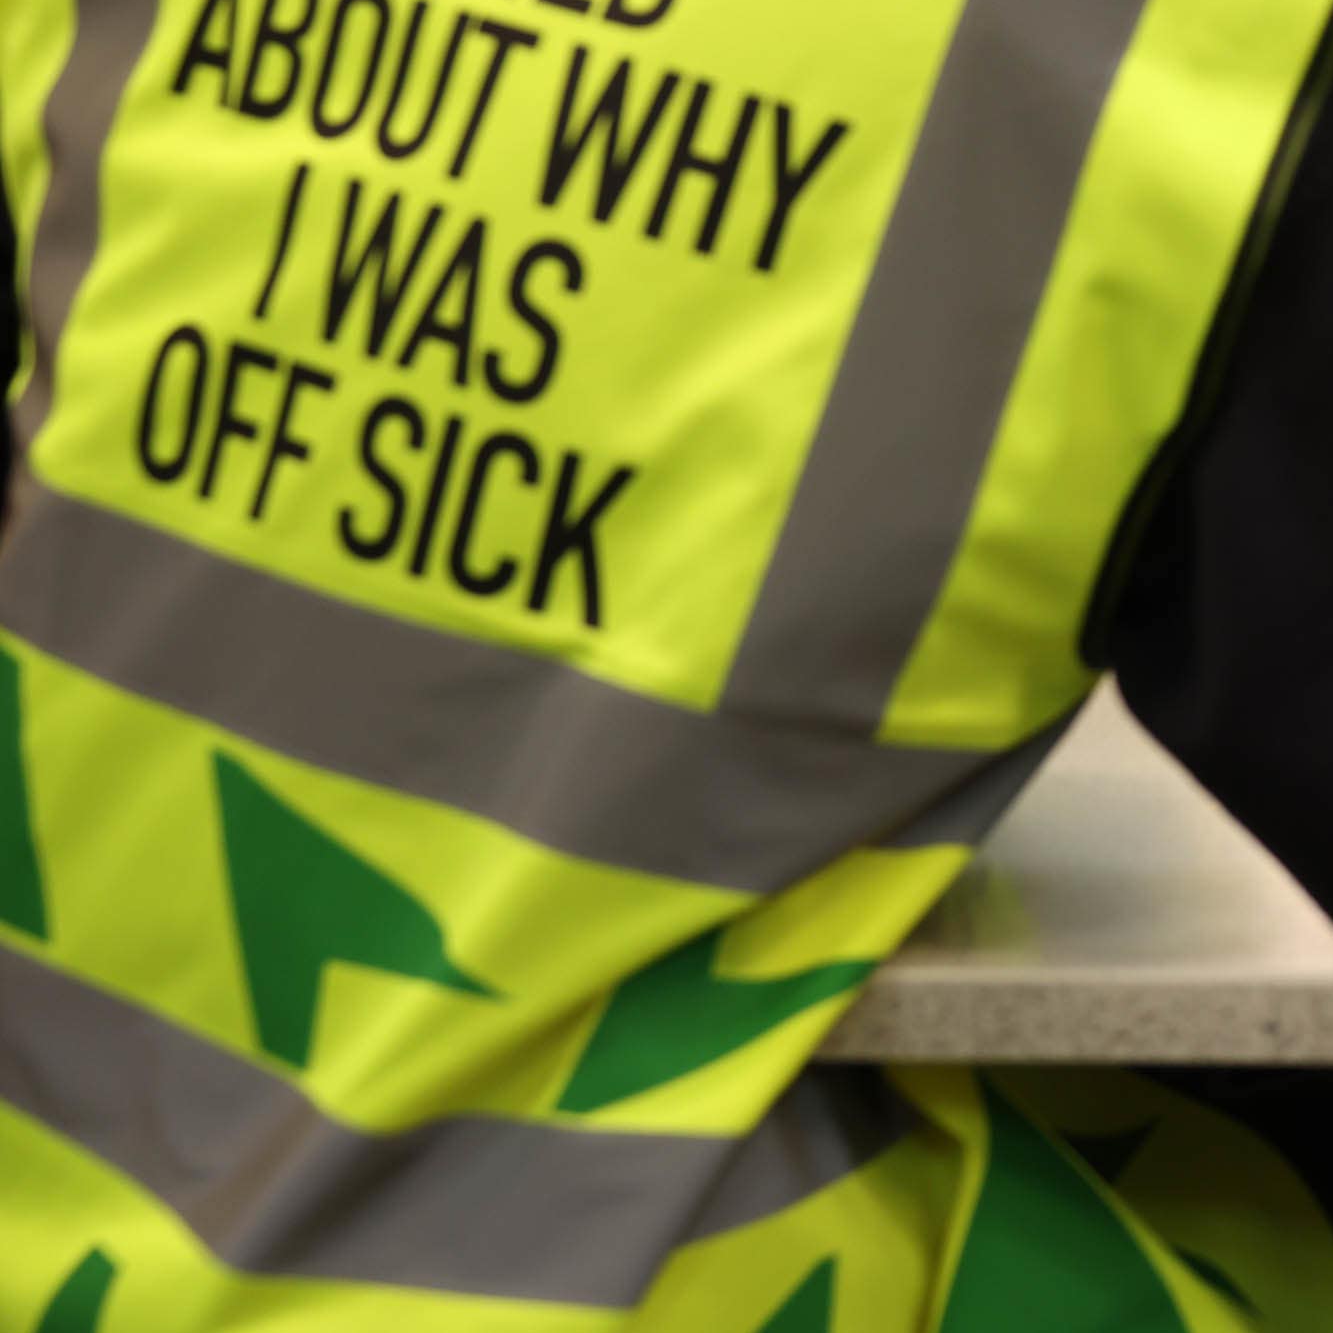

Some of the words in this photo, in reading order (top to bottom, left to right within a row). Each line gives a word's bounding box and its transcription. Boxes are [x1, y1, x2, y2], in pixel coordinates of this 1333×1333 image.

[536, 43, 853, 273] WHY
[252, 162, 309, 324] I
[321, 177, 587, 405] WAS
[136, 323, 338, 522] OFF
[336, 395, 638, 630] SICK
